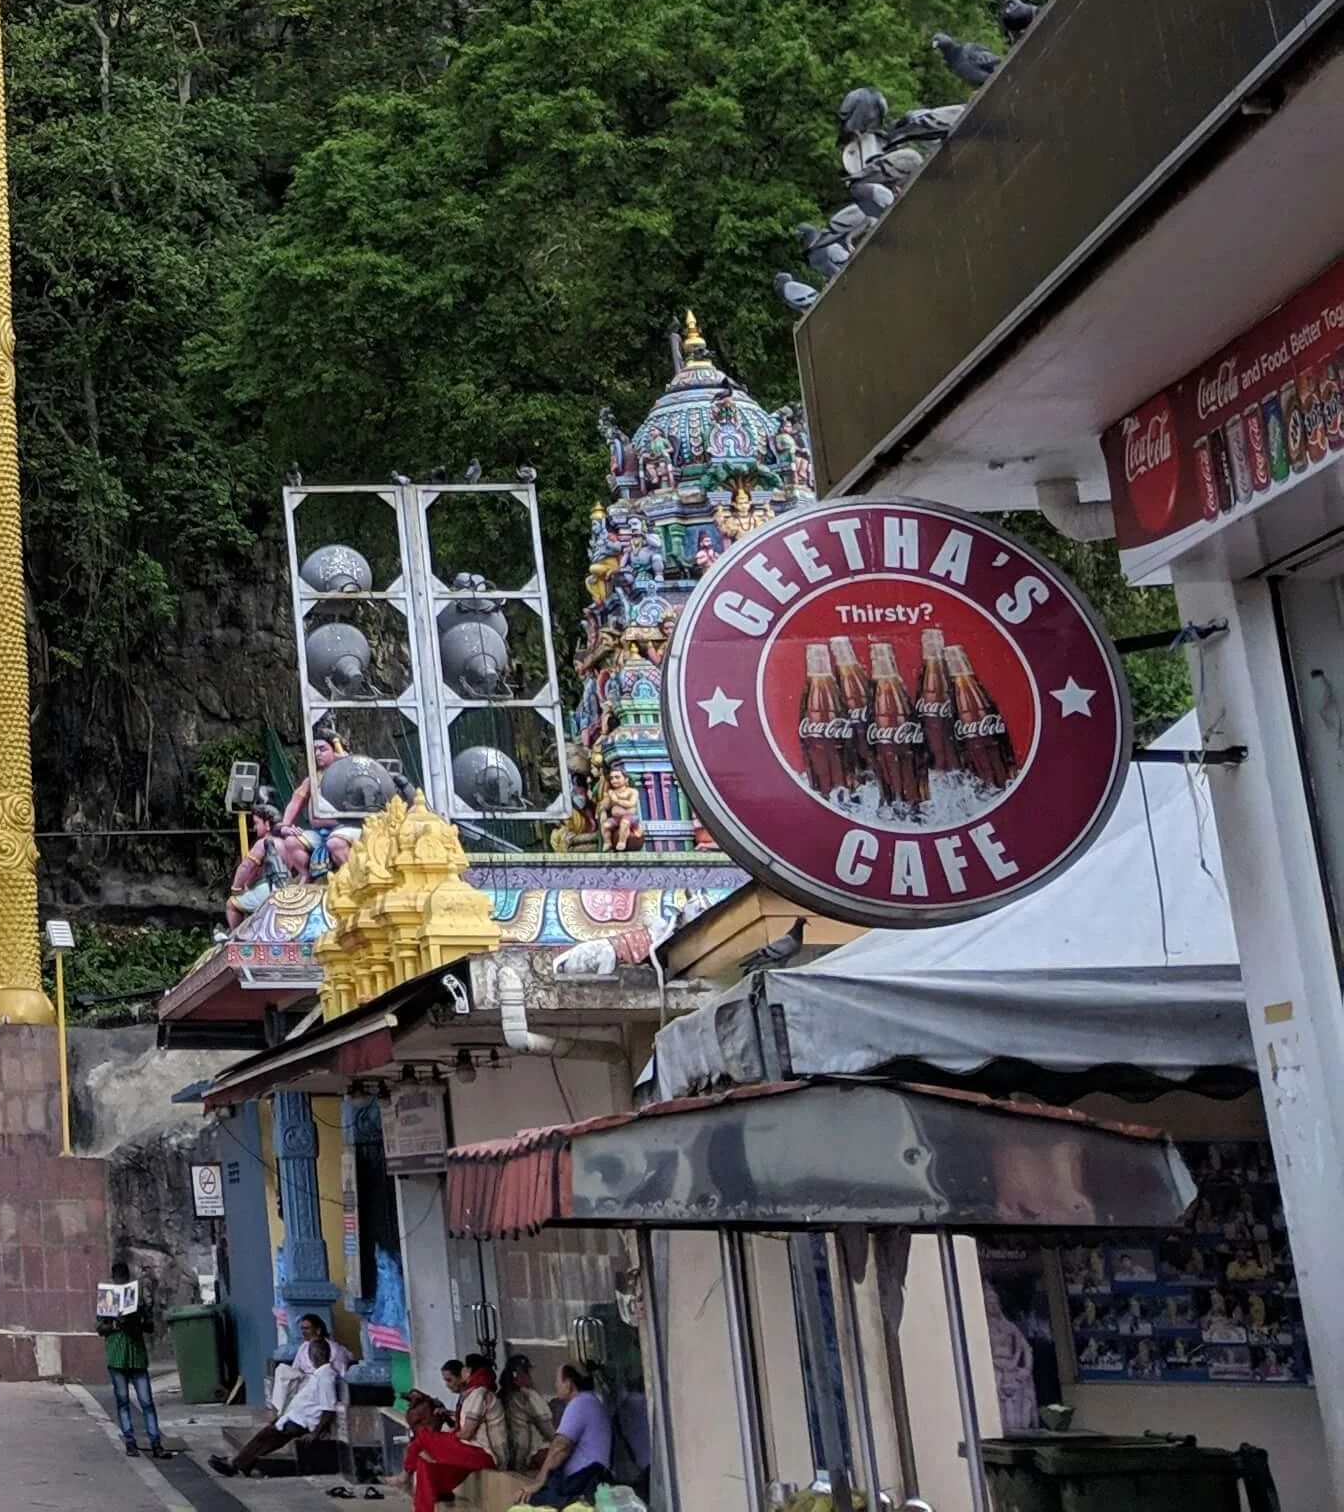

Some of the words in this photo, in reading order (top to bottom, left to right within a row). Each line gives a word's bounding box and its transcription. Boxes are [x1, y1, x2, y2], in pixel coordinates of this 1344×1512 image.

[1197, 356, 1239, 420] Coca-Cola
[1240, 359, 1261, 390] and
[1260, 340, 1291, 376] Food.
[1290, 320, 1322, 355] Better
[1125, 409, 1172, 483] Coca-Cola
[713, 516, 1050, 637] GEETHA'S
[835, 603, 934, 625] Thirsty?
[799, 717, 854, 739] Coca-Cola
[867, 722, 924, 745] Coca-Cola
[954, 714, 1006, 740] Coca-Cola
[835, 821, 1020, 898] CAFE
